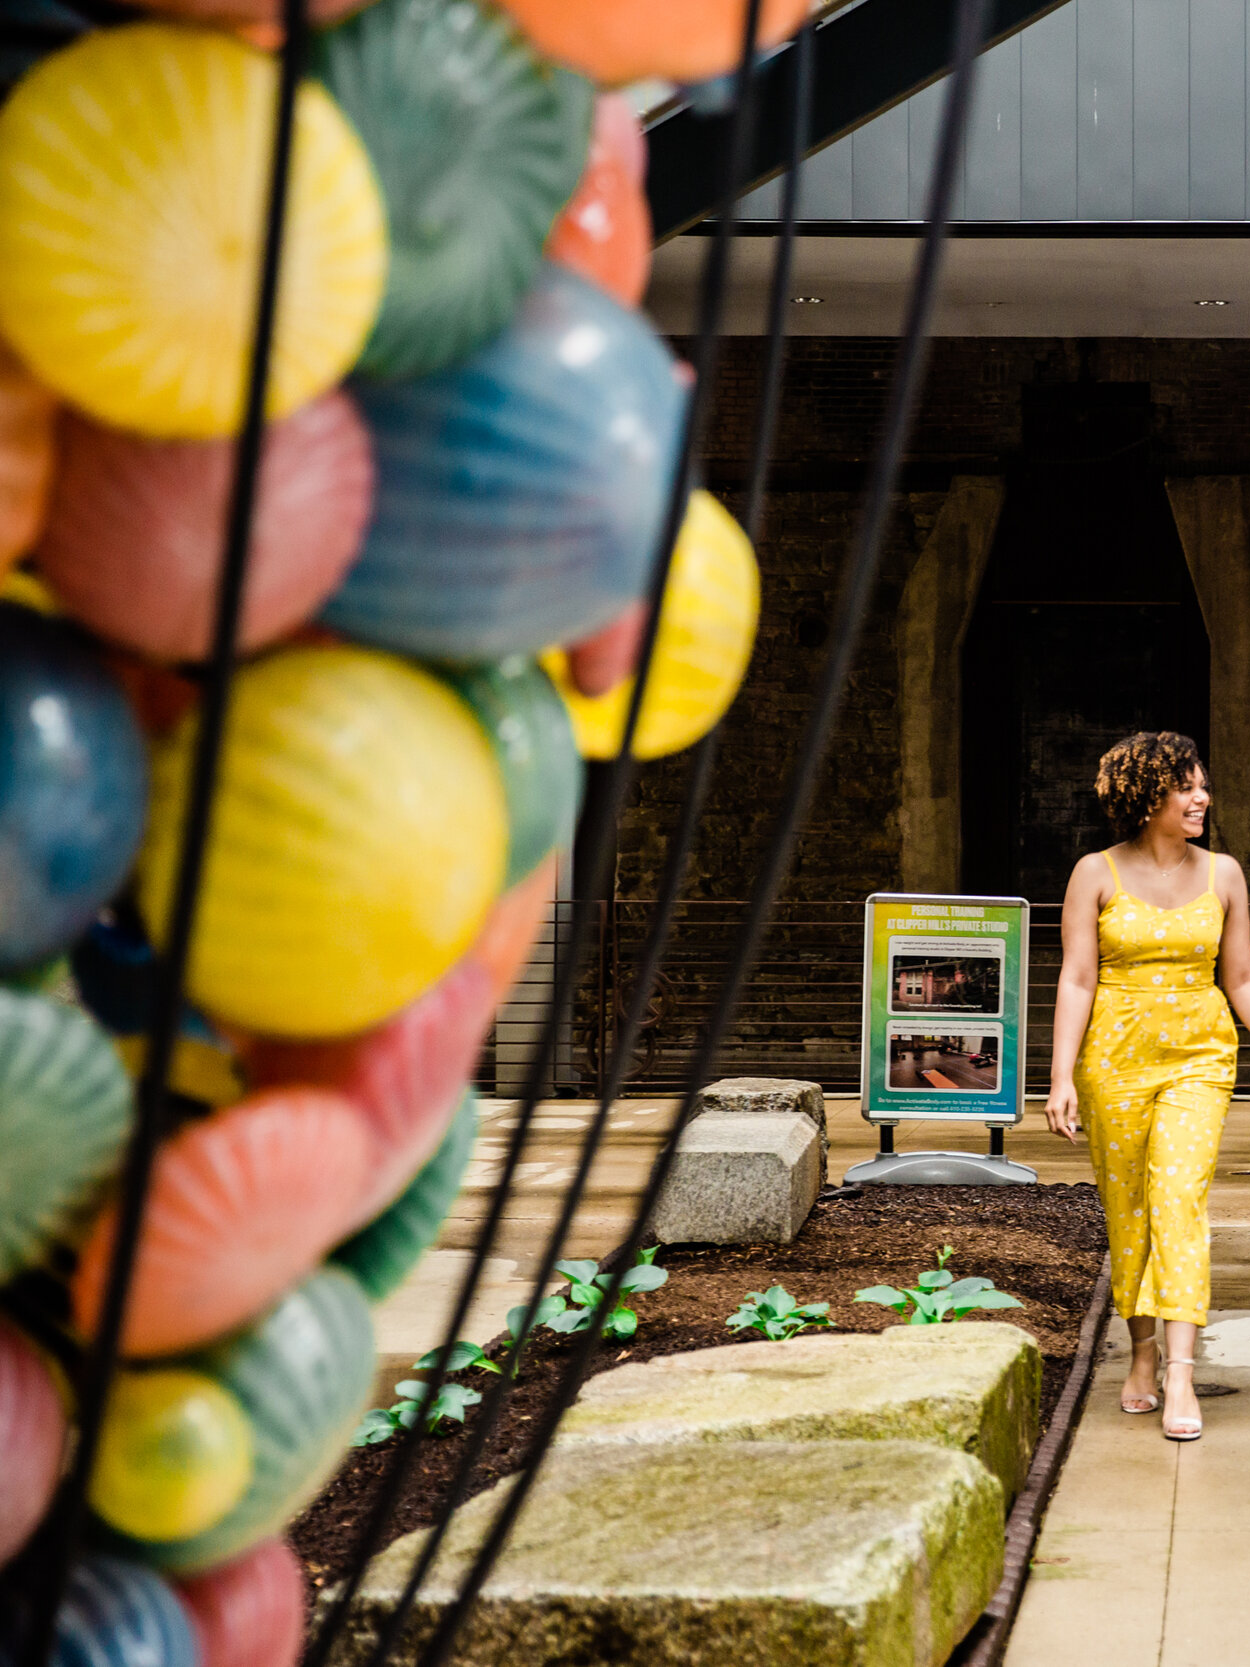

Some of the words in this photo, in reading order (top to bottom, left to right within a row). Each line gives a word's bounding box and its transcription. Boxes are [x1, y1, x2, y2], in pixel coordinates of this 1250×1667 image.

[911, 904, 950, 916] PERSONAL
[950, 905, 985, 917] TRAINING
[886, 918, 896, 929] AT
[896, 918, 927, 930] CLIPPER
[951, 920, 981, 931] PRIVATE
[981, 921, 1009, 933] STUDIO
